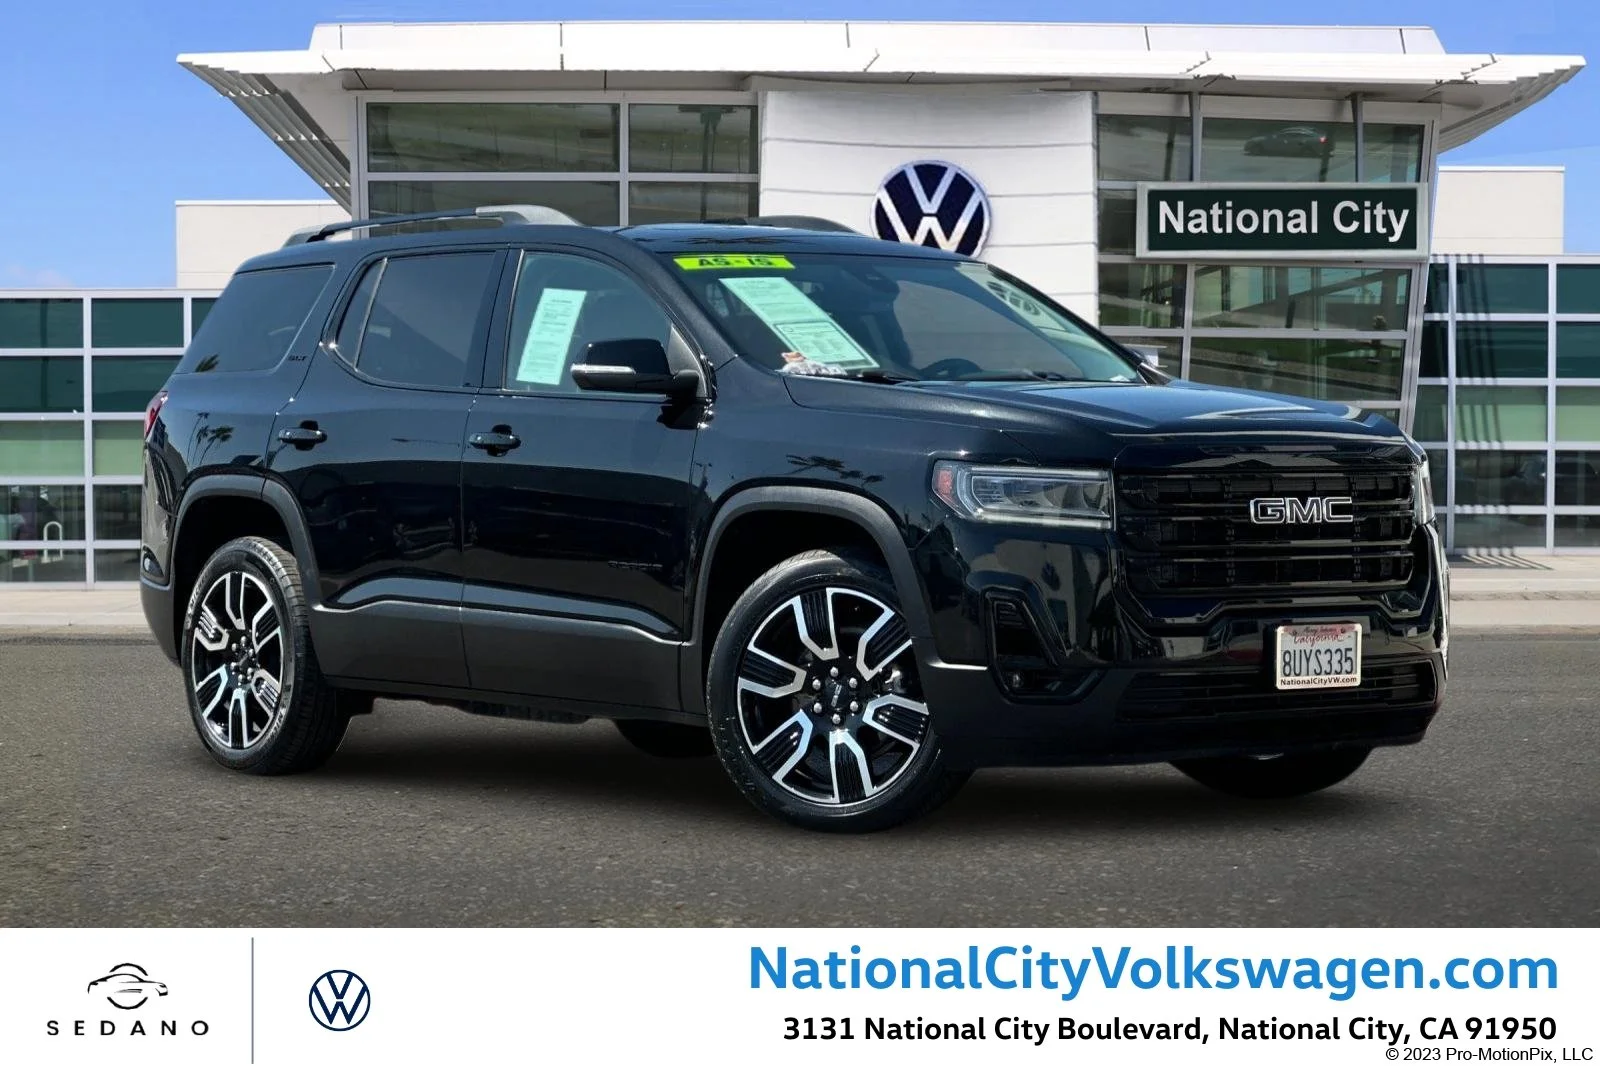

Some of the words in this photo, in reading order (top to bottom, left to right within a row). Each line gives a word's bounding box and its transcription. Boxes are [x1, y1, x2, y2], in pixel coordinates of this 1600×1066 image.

[1158, 200, 1319, 234] National
[1332, 200, 1410, 243] City
[1249, 496, 1354, 524] GMC
[1282, 647, 1354, 677] 8UYS335
[1280, 676, 1358, 686] NationalCityVW.com
